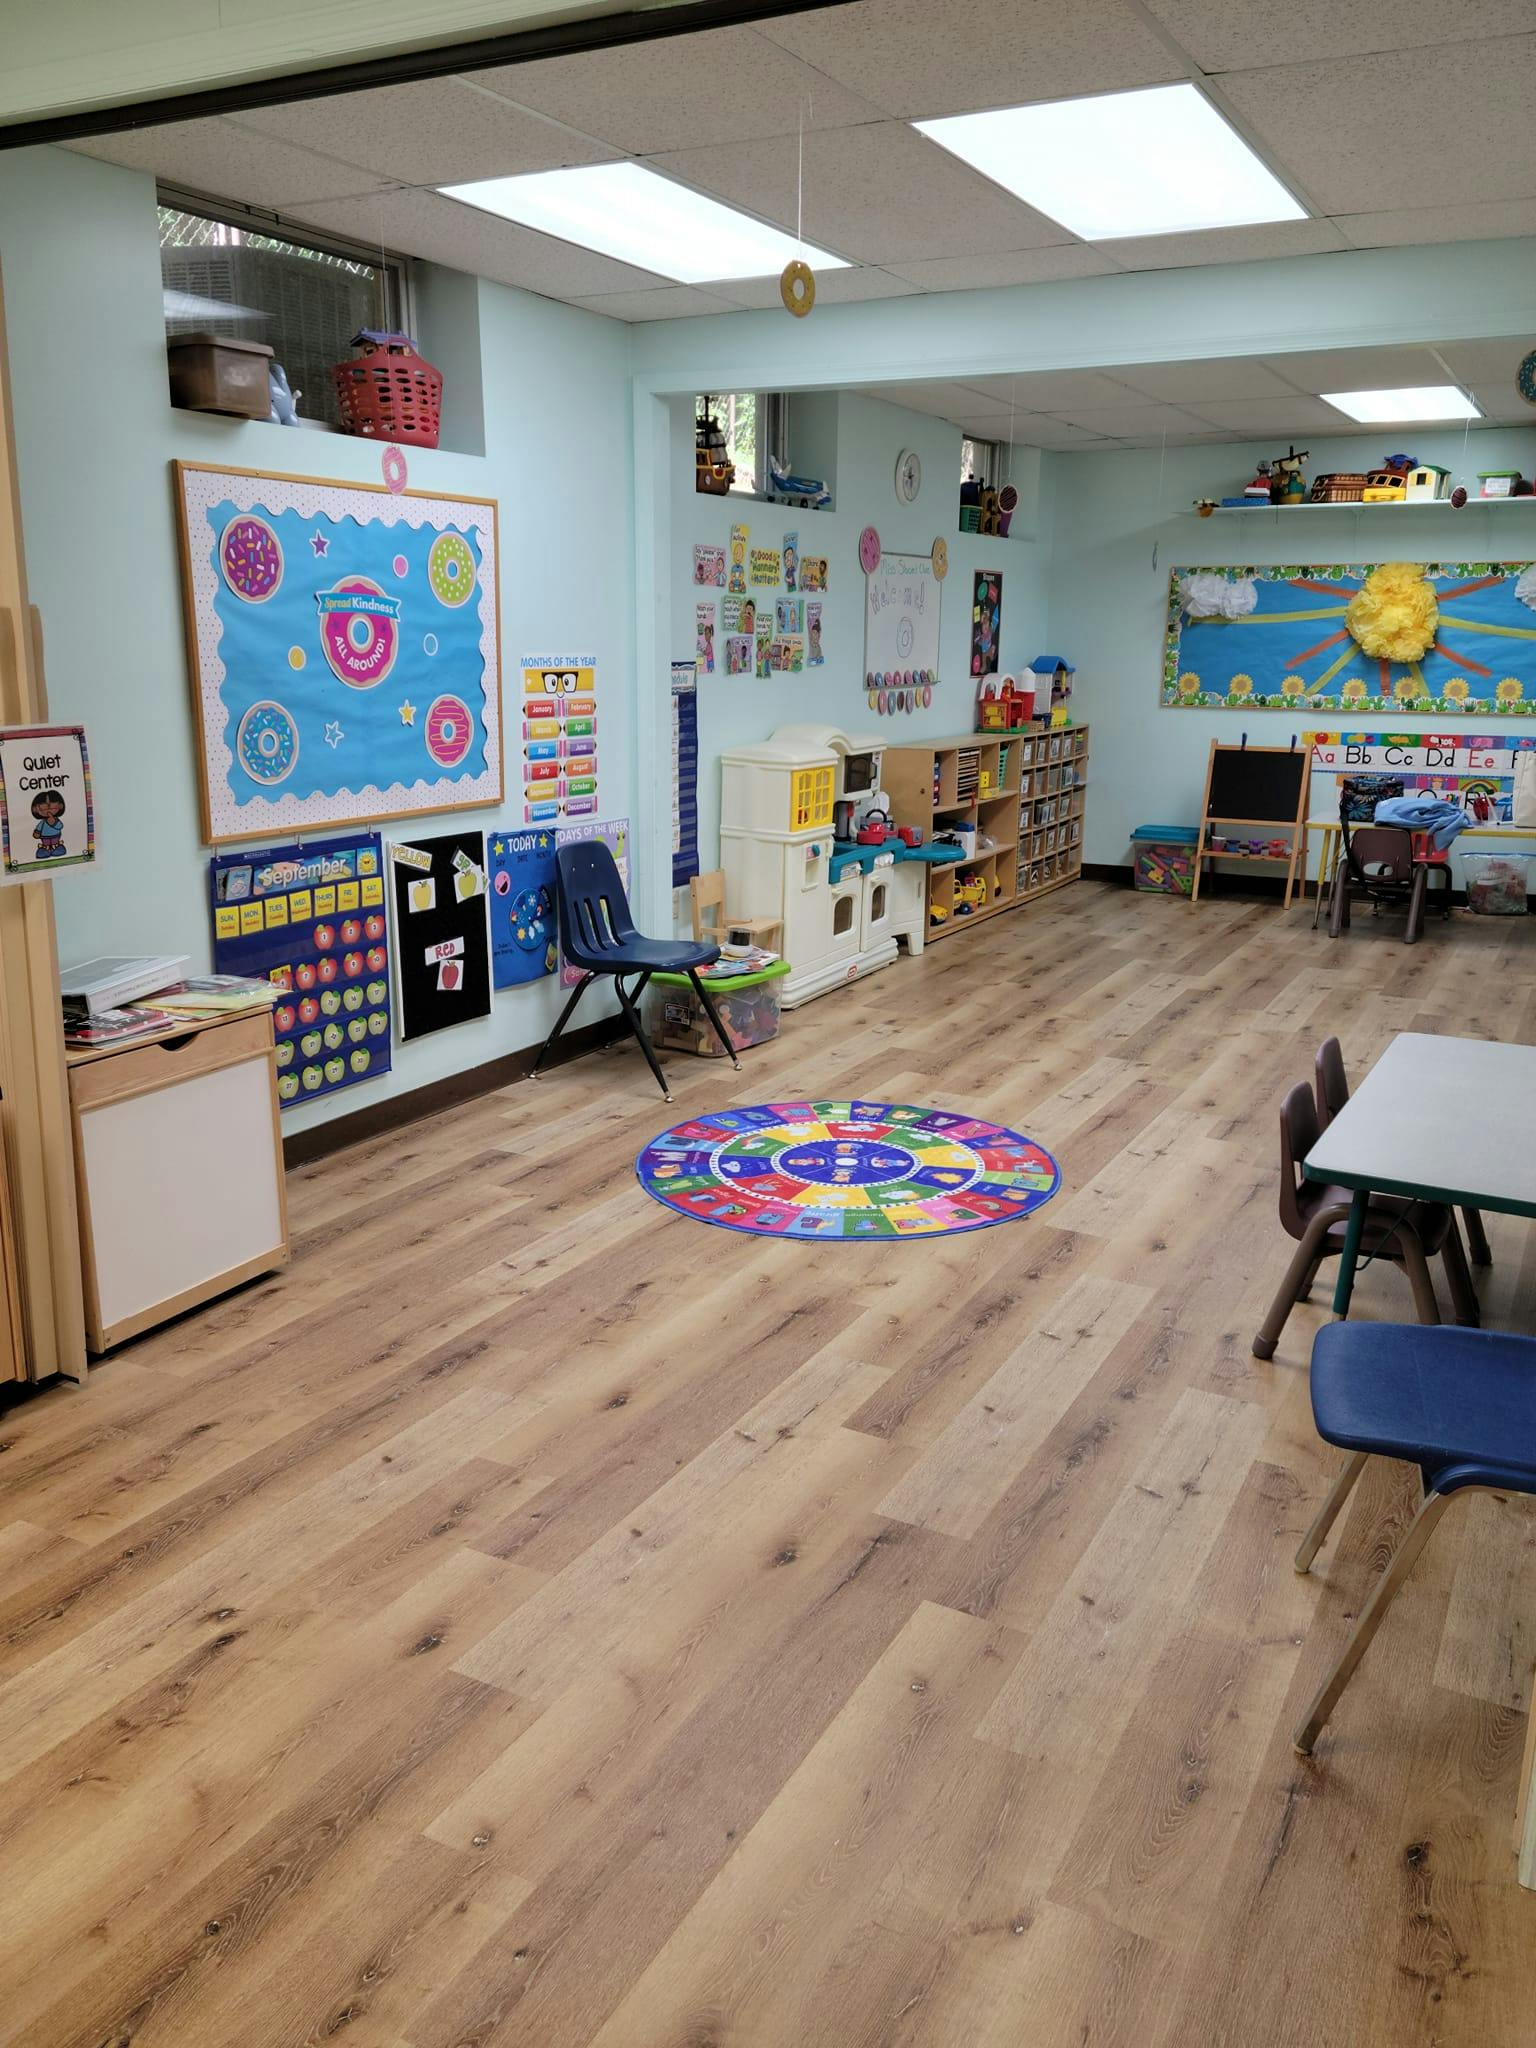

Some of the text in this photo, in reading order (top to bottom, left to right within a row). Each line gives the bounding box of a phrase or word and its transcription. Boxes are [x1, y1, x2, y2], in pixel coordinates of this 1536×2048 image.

[352, 597, 394, 614] Kindness
[334, 636, 386, 671] ALL AROUND!
[520, 656, 597, 668] MONTHS OF THE YEAR
[23, 754, 61, 771] Quiet
[1345, 745, 1372, 765] Bb
[1384, 746, 1414, 766] Cc
[1425, 746, 1456, 768] Dd
[1468, 748, 1496, 769] Ee
[19, 774, 69, 791] Center
[559, 820, 630, 843] DAYS OF THE WEEK
[507, 834, 538, 854] TODAY
[258, 857, 347, 888] September
